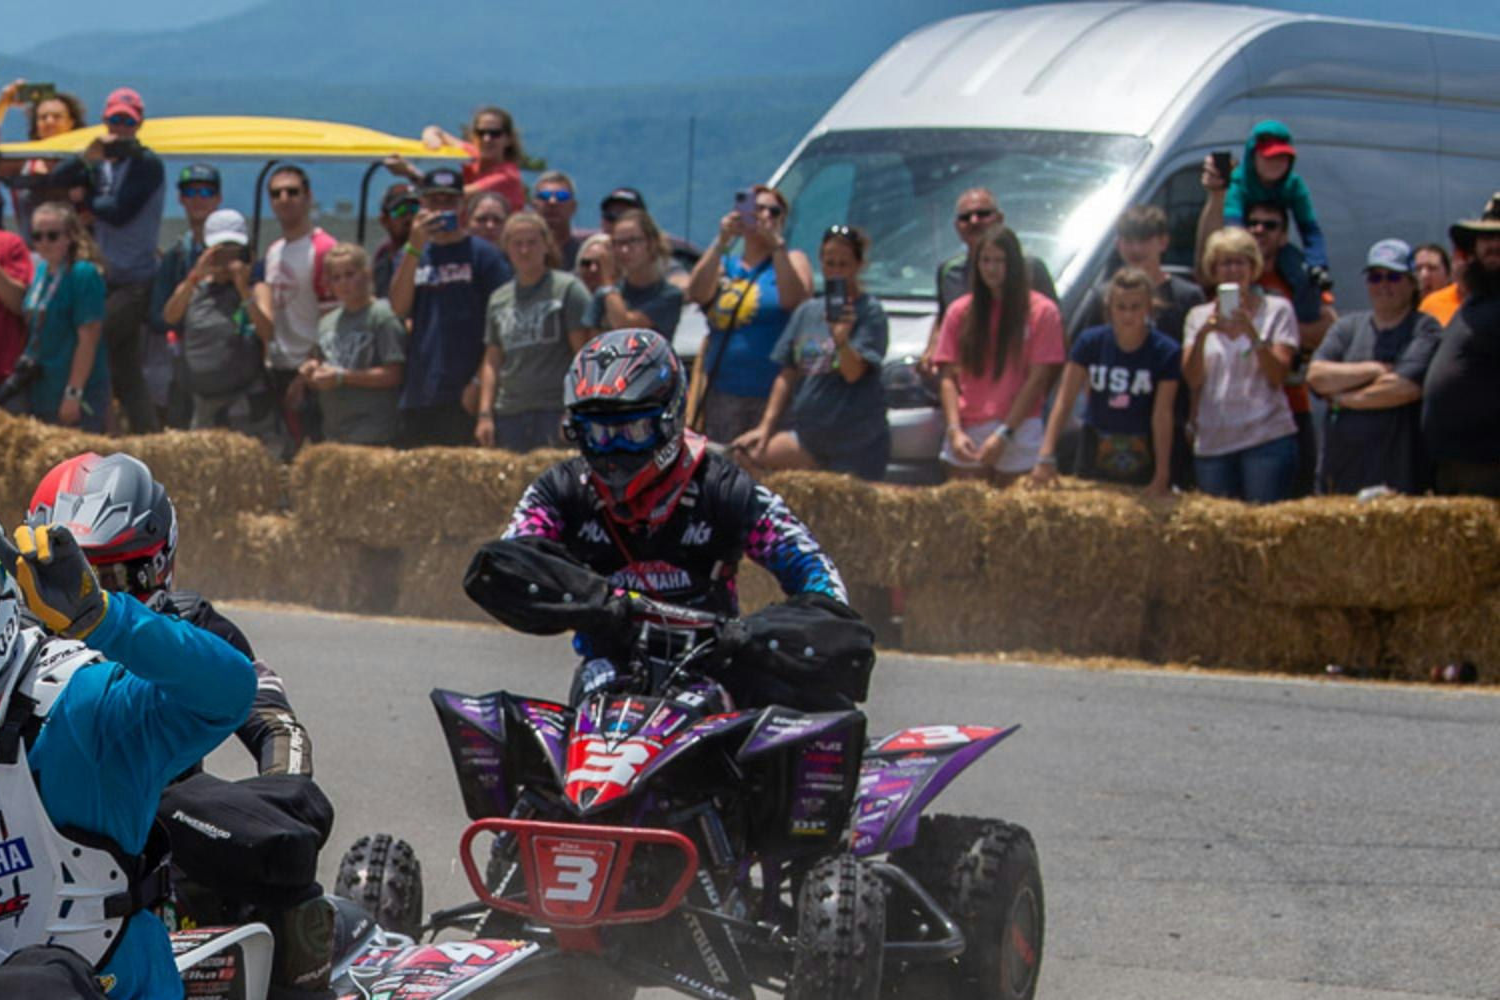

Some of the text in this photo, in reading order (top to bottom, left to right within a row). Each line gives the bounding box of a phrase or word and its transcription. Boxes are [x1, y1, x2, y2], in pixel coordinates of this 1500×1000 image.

[1088, 363, 1153, 393] USA
[625, 570, 692, 591] YAMAHA
[566, 741, 650, 787] 3
[545, 854, 598, 902] 3
[434, 941, 496, 962] 4
